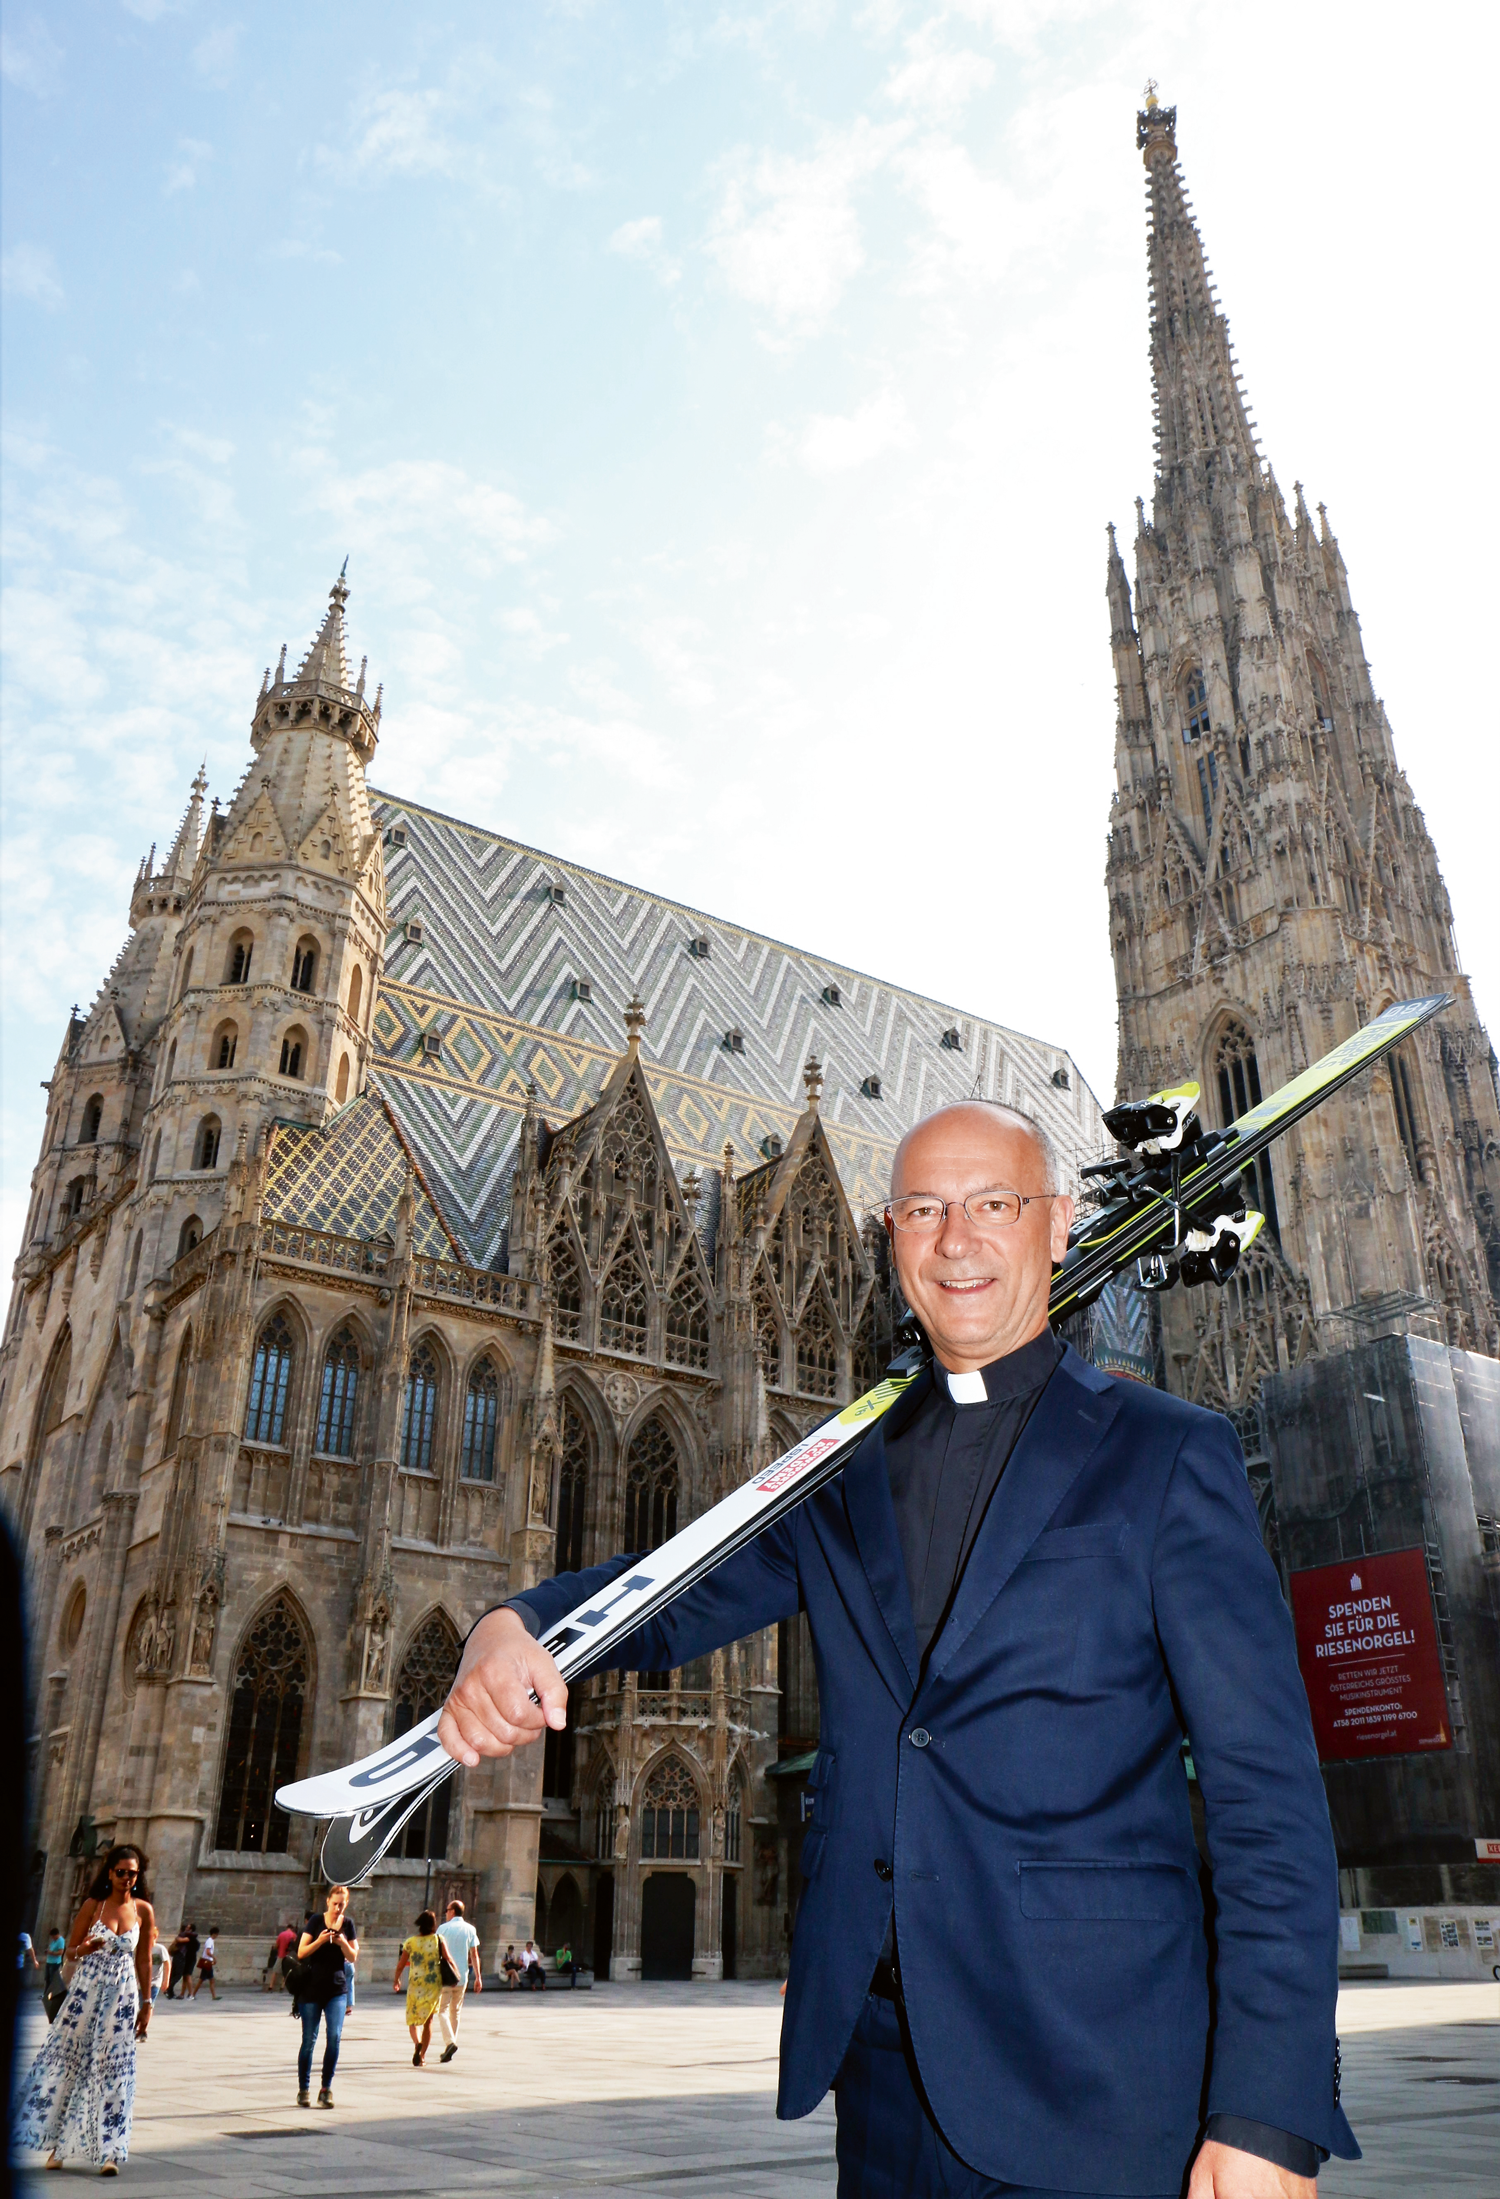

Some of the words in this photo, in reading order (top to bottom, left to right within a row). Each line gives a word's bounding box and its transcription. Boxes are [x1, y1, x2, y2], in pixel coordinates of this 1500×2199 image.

[1316, 1026, 1388, 1069] REBELS
[764, 1441, 825, 1488] ACADEMY
[771, 1441, 834, 1489] SNOWSPORTS
[1328, 1595, 1391, 1618] SPENDEN
[1324, 1622, 1345, 1638] SIE
[1347, 1615, 1374, 1634] FÜR
[1376, 1613, 1400, 1629] DIE
[1315, 1629, 1415, 1658] RIESENORGEL!
[1338, 1670, 1363, 1680] RETTEN
[1363, 1668, 1377, 1676] WIR
[1379, 1665, 1398, 1675] JETZT
[1329, 1679, 1374, 1692] ÖSTERREICHS
[1375, 1674, 1411, 1686] GRÖSSTES
[1339, 1686, 1403, 1701] MUSIKINSTRUMENT
[1344, 1702, 1402, 1716] SPENDENKONTO:
[1350, 1716, 1365, 1726] 2011
[1382, 1713, 1397, 1722] 1199
[1398, 1710, 1417, 1720] 6700
[1356, 1729, 1397, 1741] riesenorgel.at
